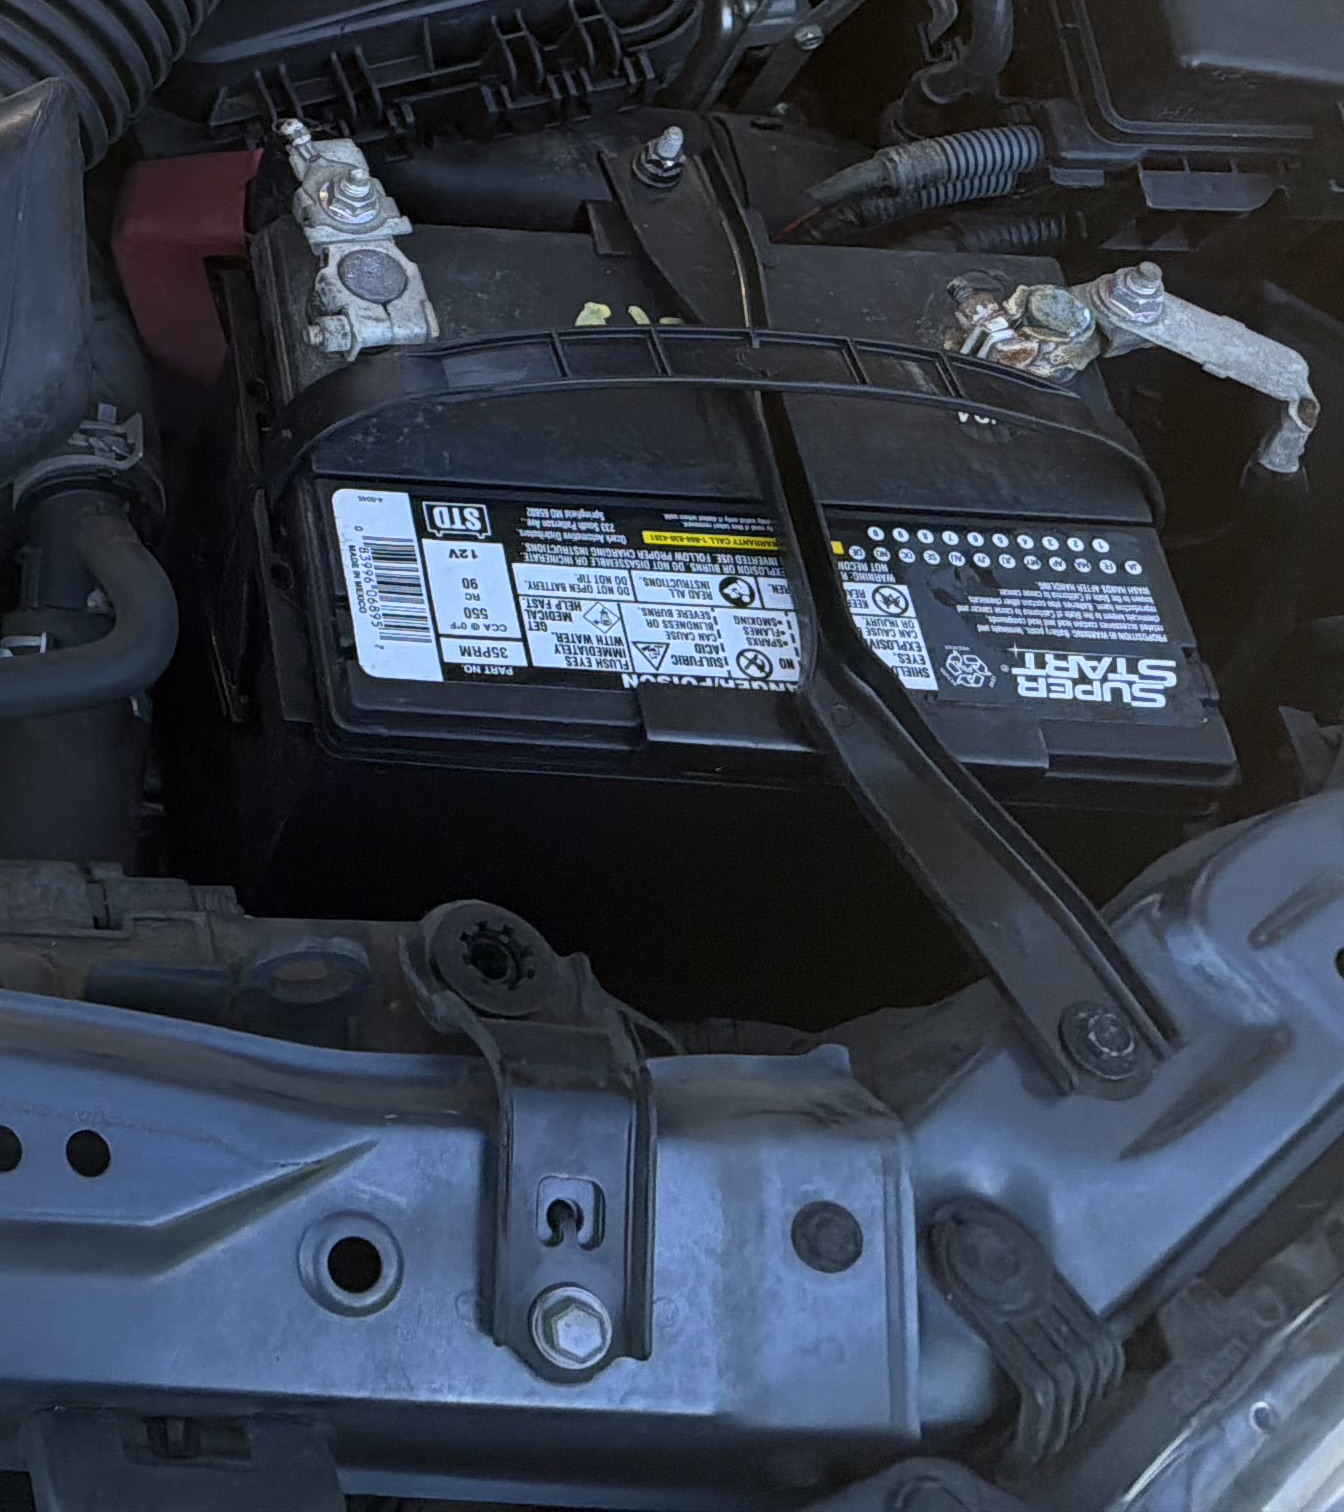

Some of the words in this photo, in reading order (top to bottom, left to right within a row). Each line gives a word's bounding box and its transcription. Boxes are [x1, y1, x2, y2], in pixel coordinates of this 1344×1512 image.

[432, 506, 482, 530] STD
[708, 537, 731, 546] CALL
[348, 545, 359, 568] MADE
[448, 549, 478, 559] 12V
[589, 547, 636, 558] CHARGING
[636, 550, 672, 560] PROPER
[674, 552, 711, 562] FOLLOW
[574, 557, 588, 566] OR
[589, 557, 650, 569] DISASSEMBLE
[652, 561, 670, 570] NOT
[735, 555, 778, 566] INVERTED
[672, 562, 684, 571] DO
[722, 565, 736, 574] OR
[869, 562, 888, 572] NOT
[462, 578, 478, 589] 90
[594, 575, 611, 584] NOT
[615, 576, 627, 586] DO
[524, 580, 566, 592] BATTERY.
[568, 583, 593, 593] OPEN
[596, 585, 614, 595] NOT
[617, 586, 630, 596] DO
[464, 592, 480, 601] RC
[668, 589, 686, 599] ALL
[688, 590, 713, 600] READ
[521, 598, 552, 609] FAST.
[555, 600, 582, 611] HELP
[463, 607, 488, 619] 550
[524, 609, 573, 622] MEDICAL
[675, 610, 711, 619] SEVERE
[645, 619, 660, 629] OR
[733, 615, 777, 625] SMOKING
[901, 619, 914, 629] OR
[482, 623, 507, 632] CCA
[528, 621, 548, 632] GET
[662, 619, 714, 632] BLINDNESS
[664, 631, 696, 641] CAUSE
[743, 626, 780, 636] FLAMES
[865, 627, 896, 638] CAUSE
[898, 629, 918, 638] CAN
[551, 632, 593, 644] WATER.
[595, 634, 624, 646] WITH
[698, 632, 717, 642] CAN
[746, 637, 783, 648] SPARKS
[459, 645, 508, 659] 35PRM
[554, 643, 626, 658] IMMEDIATELY
[694, 643, 720, 655] ACID
[564, 656, 593, 668] EYES
[595, 657, 630, 670] FLUSH
[670, 655, 723, 668] SULFURIC
[779, 658, 795, 670] NO
[460, 664, 482, 673] NO.
[483, 664, 514, 675] PART
[1011, 652, 1177, 687] START
[1016, 676, 1166, 708] SUPER
